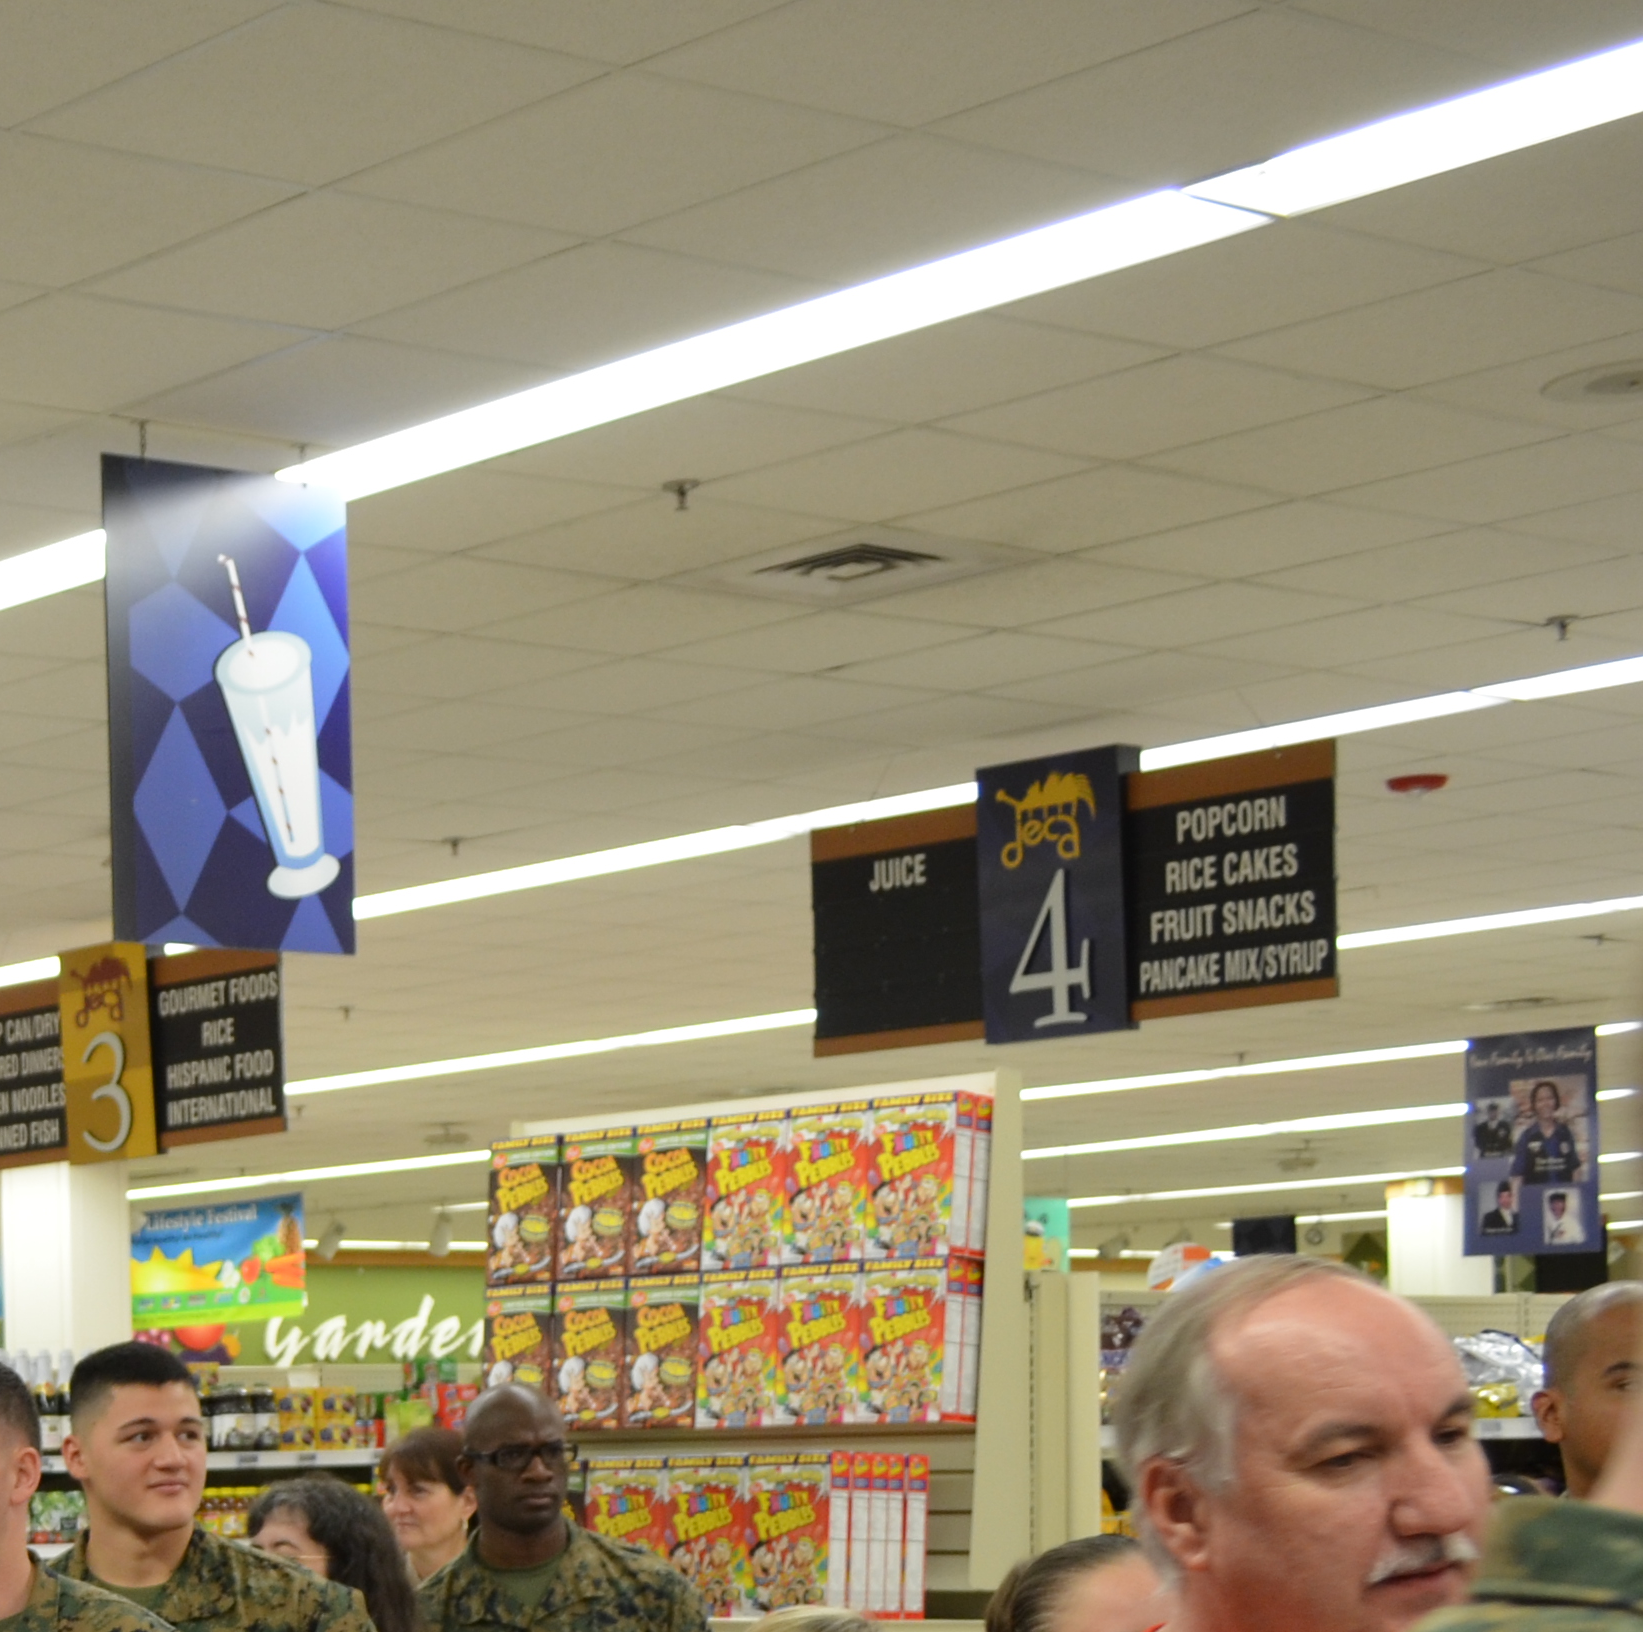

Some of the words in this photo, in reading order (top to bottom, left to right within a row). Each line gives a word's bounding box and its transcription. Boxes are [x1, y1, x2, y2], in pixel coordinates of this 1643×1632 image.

[1176, 795, 1286, 844] POPCORN
[869, 854, 927, 892] JUICE
[1166, 855, 1218, 894] RICE
[1223, 843, 1298, 886] CAKES
[1150, 903, 1217, 944] FRUIT
[1222, 890, 1316, 935] SNACKS
[1009, 868, 1091, 1029] 4
[1139, 952, 1220, 994] PANCAKE
[1224, 938, 1329, 983] MIX/SYRUP
[158, 980, 227, 1017] GOURMET
[229, 971, 279, 1003] FOODS
[202, 1017, 235, 1047] RICE
[82, 1030, 133, 1152] 3
[166, 1060, 232, 1090] HISPANIC
[234, 1049, 274, 1080] FOOD
[11, 1082, 66, 1113] NOODLES
[168, 1086, 277, 1127] INTERNATIONAL
[30, 1118, 60, 1145] FISH
